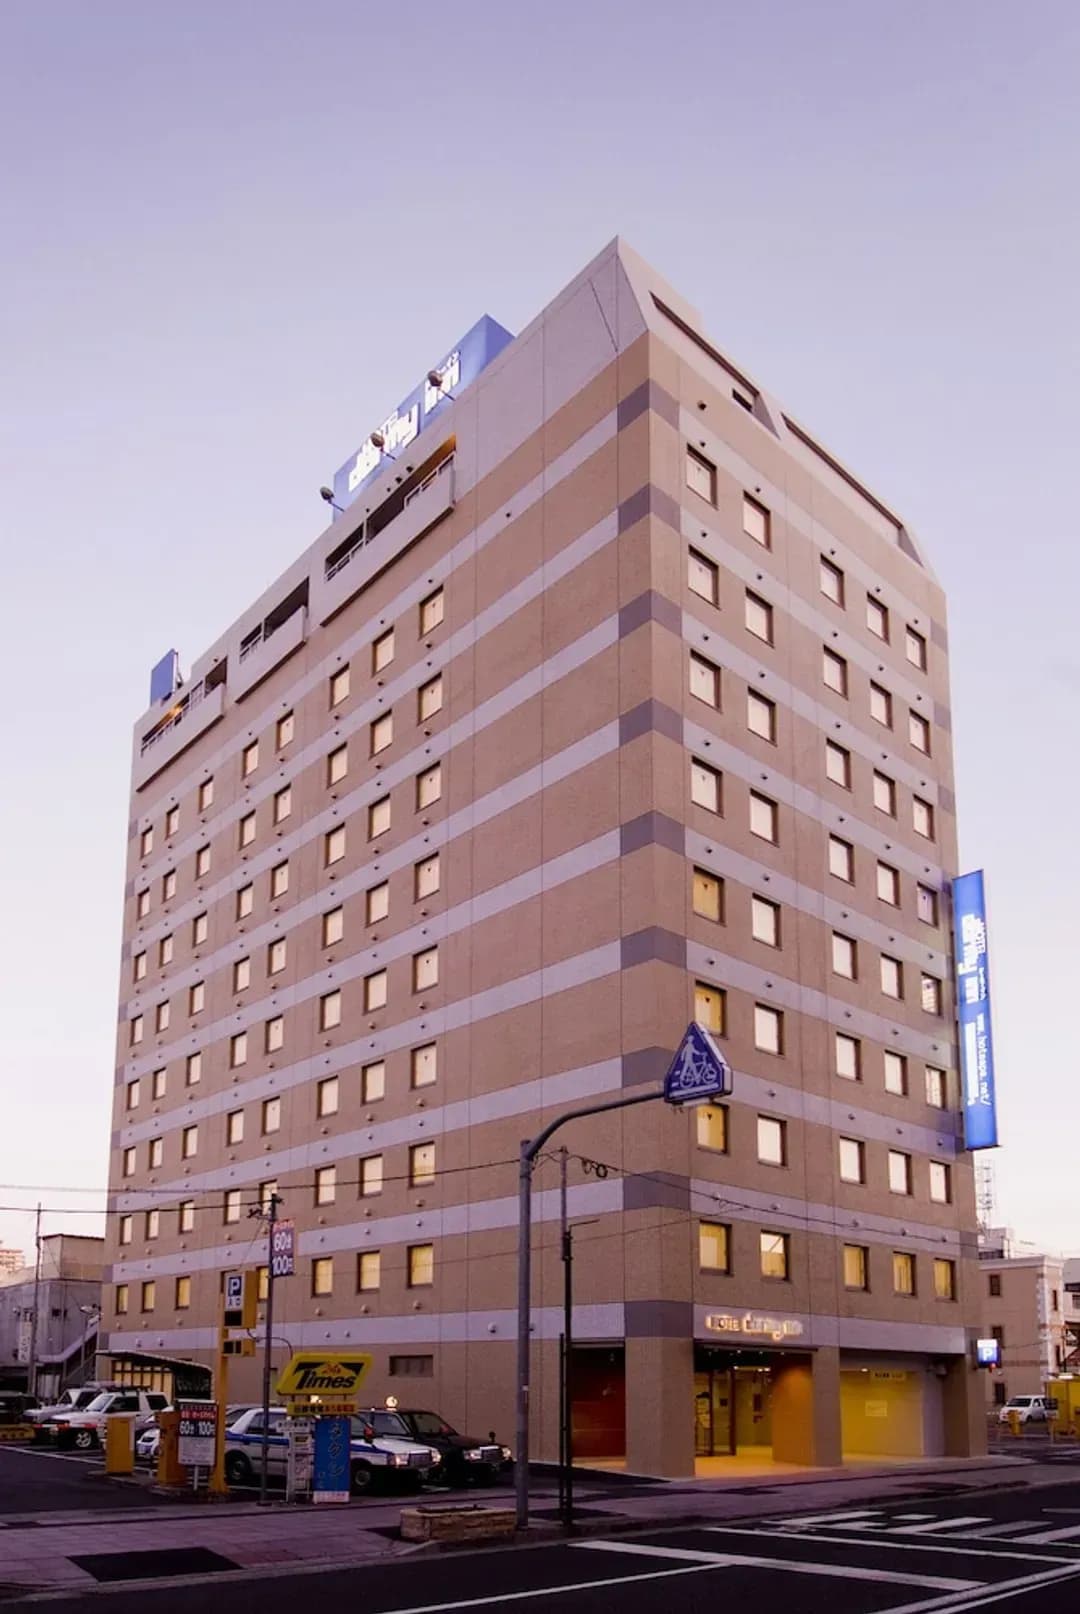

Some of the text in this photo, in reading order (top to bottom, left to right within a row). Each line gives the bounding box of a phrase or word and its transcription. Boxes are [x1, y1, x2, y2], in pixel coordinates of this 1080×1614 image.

[230, 1278, 240, 1295] P
[983, 1348, 993, 1361] P
[293, 1362, 361, 1390] Times
